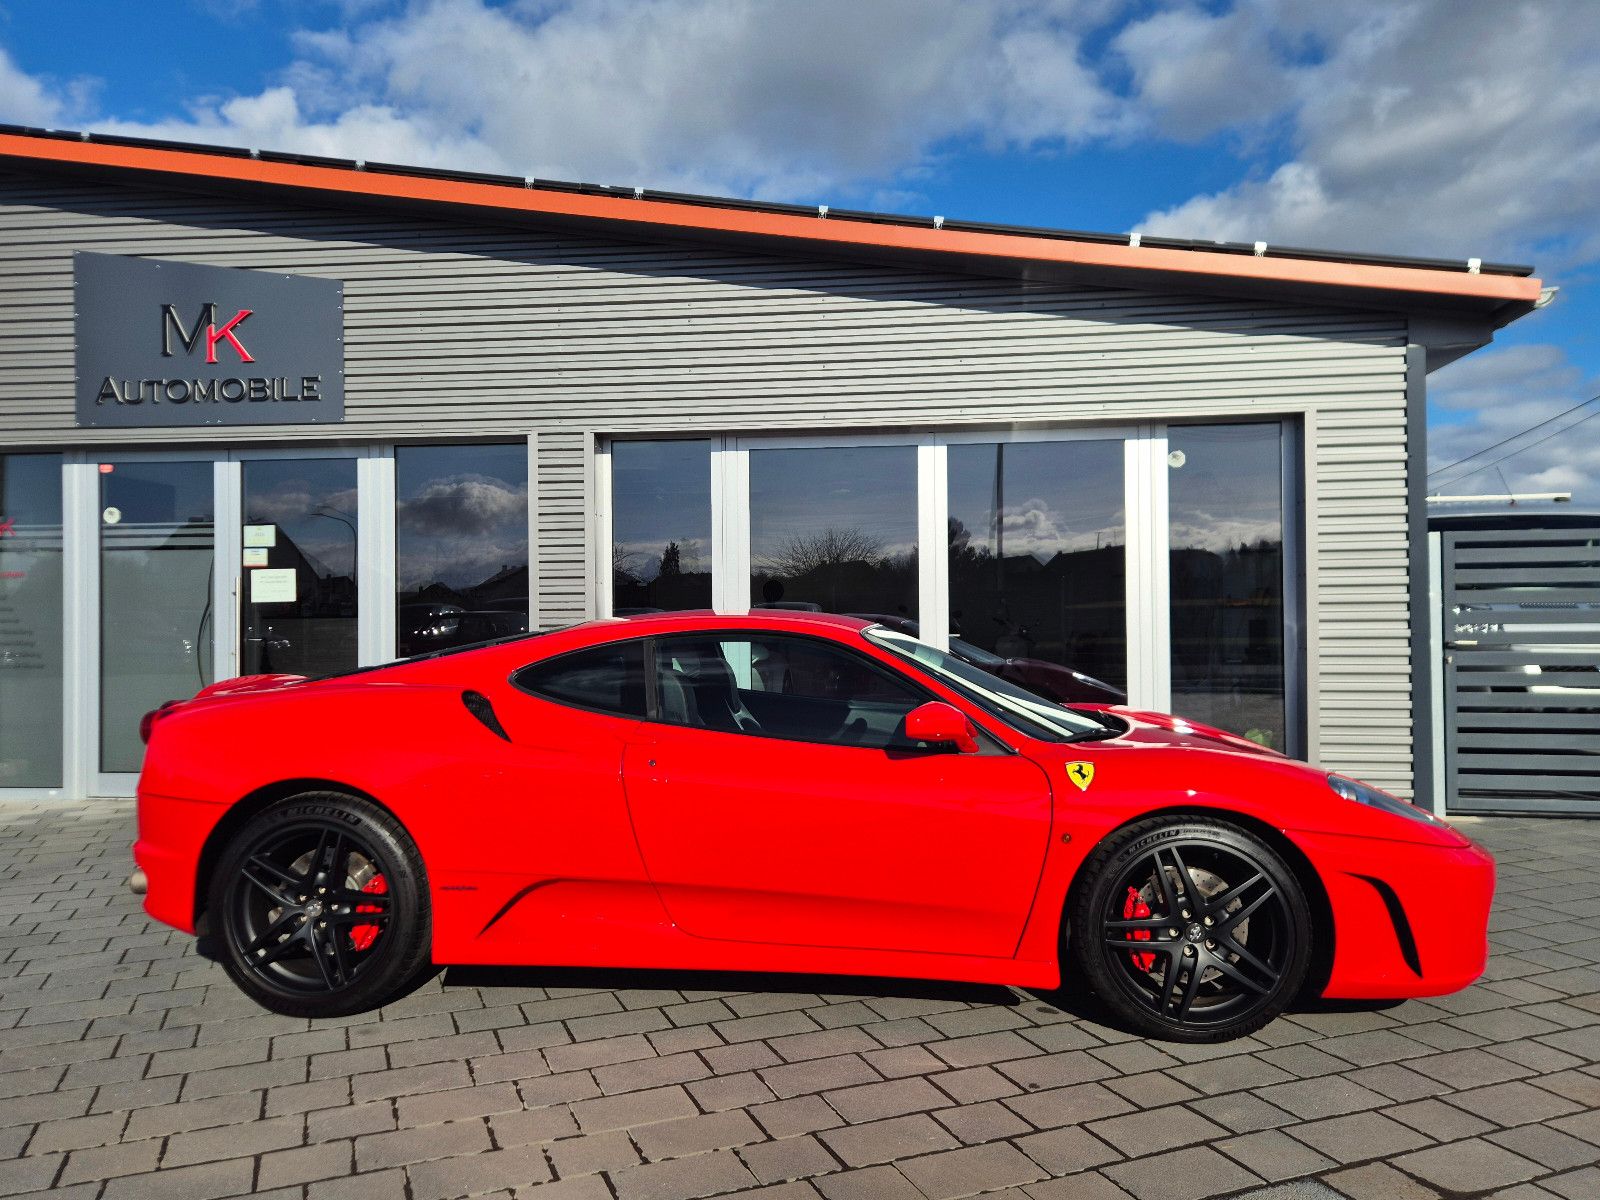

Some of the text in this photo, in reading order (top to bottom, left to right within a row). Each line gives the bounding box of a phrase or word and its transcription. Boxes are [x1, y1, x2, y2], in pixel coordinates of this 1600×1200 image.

[160, 302, 255, 363] MK
[96, 374, 321, 406] AUTOMOBILE
[287, 806, 360, 825] MICHELIN
[1128, 828, 1181, 853] MICHELIN
